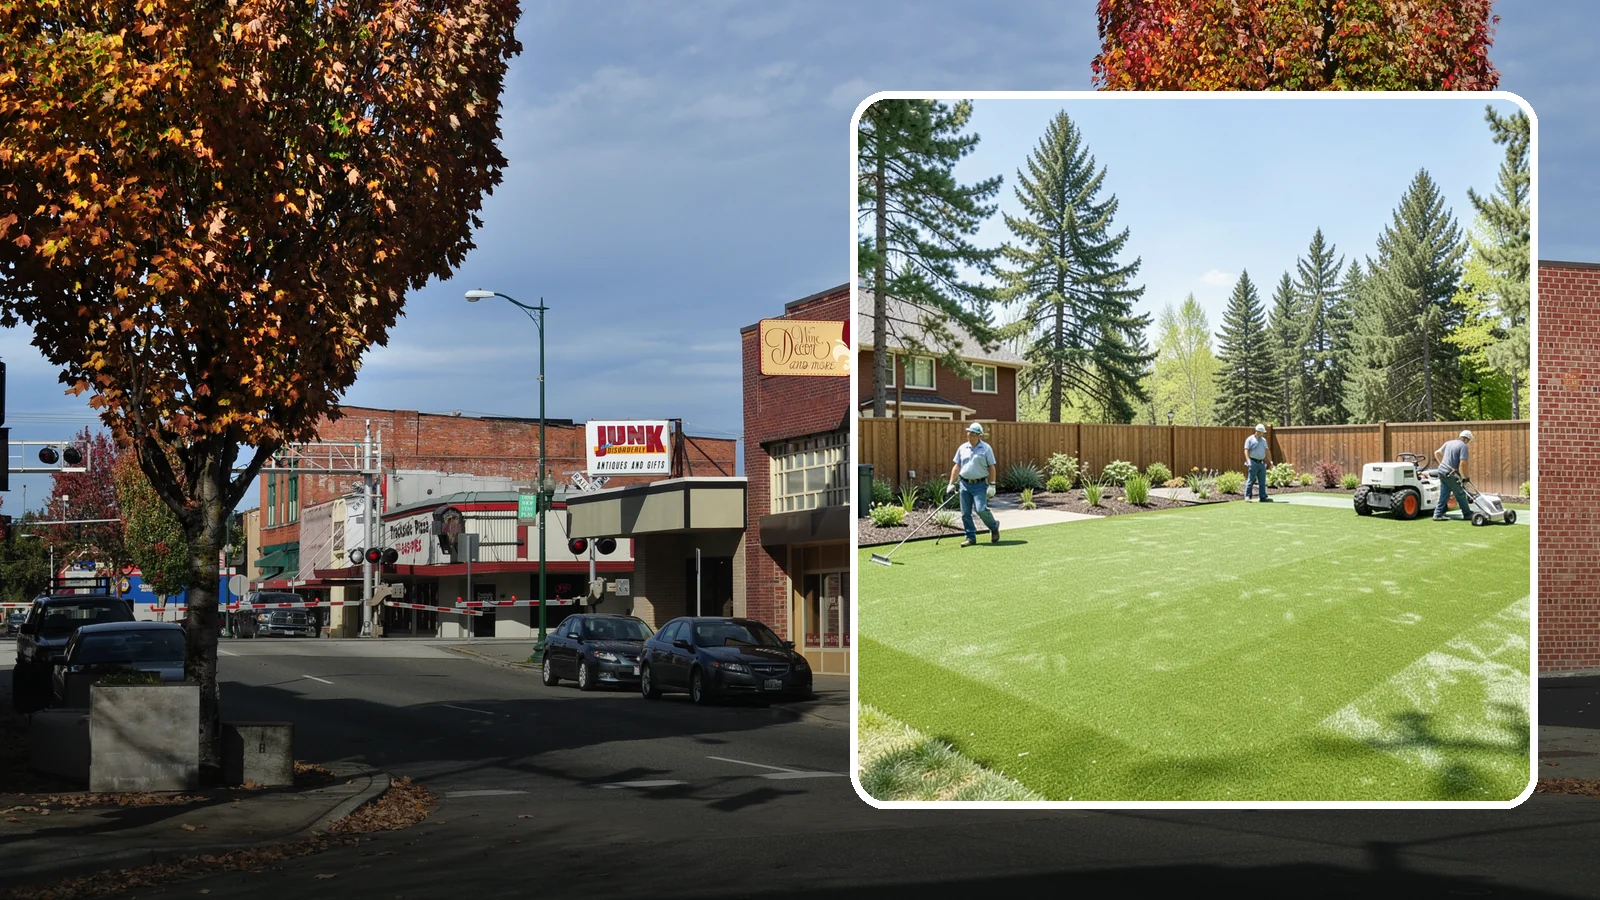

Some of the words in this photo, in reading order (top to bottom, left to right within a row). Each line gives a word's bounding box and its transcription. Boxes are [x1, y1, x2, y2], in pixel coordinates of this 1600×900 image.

[595, 425, 665, 457] JUNK
[607, 446, 646, 454] DISORDERLY
[597, 461, 628, 469] ANTIQUES
[631, 461, 644, 469] AND
[647, 461, 665, 469] GIFTS
[415, 520, 429, 534] Pizza
